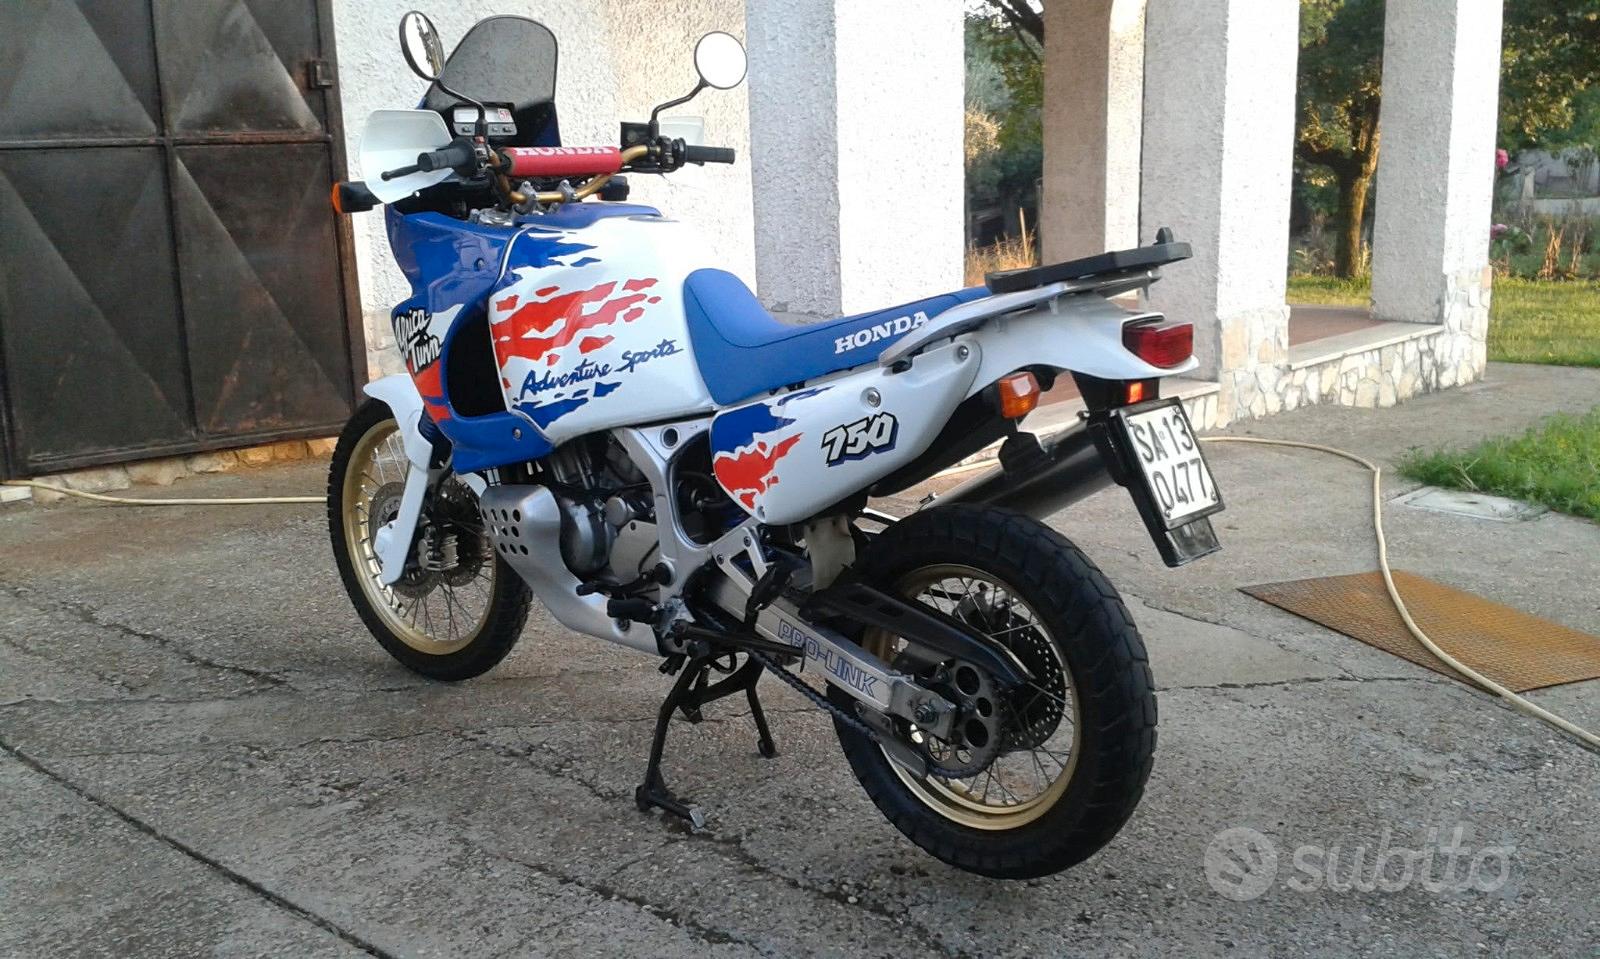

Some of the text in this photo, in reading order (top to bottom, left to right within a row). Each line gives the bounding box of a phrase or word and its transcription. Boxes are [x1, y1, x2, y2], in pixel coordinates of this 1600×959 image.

[408, 334, 442, 374] Twin
[834, 311, 930, 354] HONDA
[520, 338, 684, 401] Adventure Sports
[821, 411, 899, 467] 750
[1152, 457, 1208, 512] 0477
[778, 618, 878, 699] PRO-LINK
